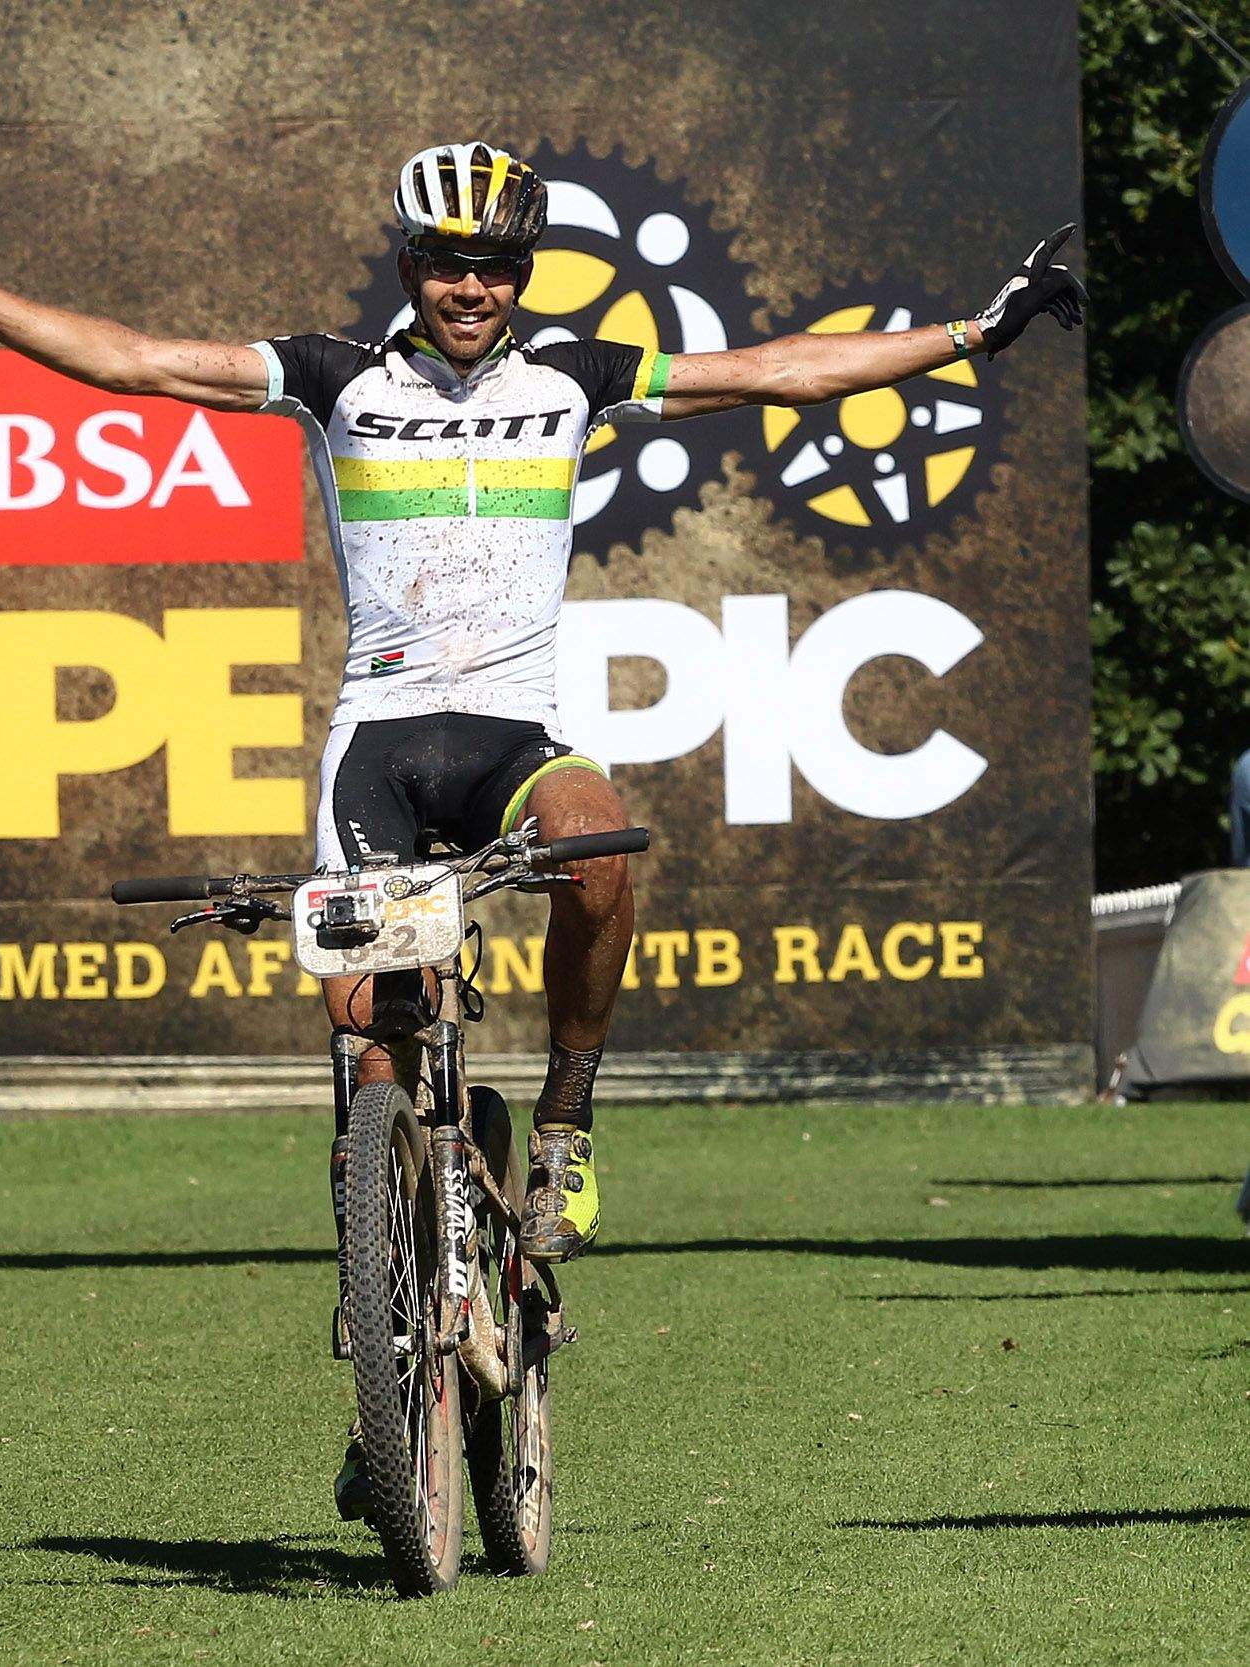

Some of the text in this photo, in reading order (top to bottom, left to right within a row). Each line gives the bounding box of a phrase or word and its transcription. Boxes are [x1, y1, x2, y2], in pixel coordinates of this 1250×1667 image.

[347, 408, 571, 441] SCOTT
[558, 590, 988, 827] PIC
[348, 819, 372, 854] OTT
[621, 928, 742, 991] TB
[772, 921, 985, 984] RACE
[444, 1167, 469, 1299] DT SWISS
